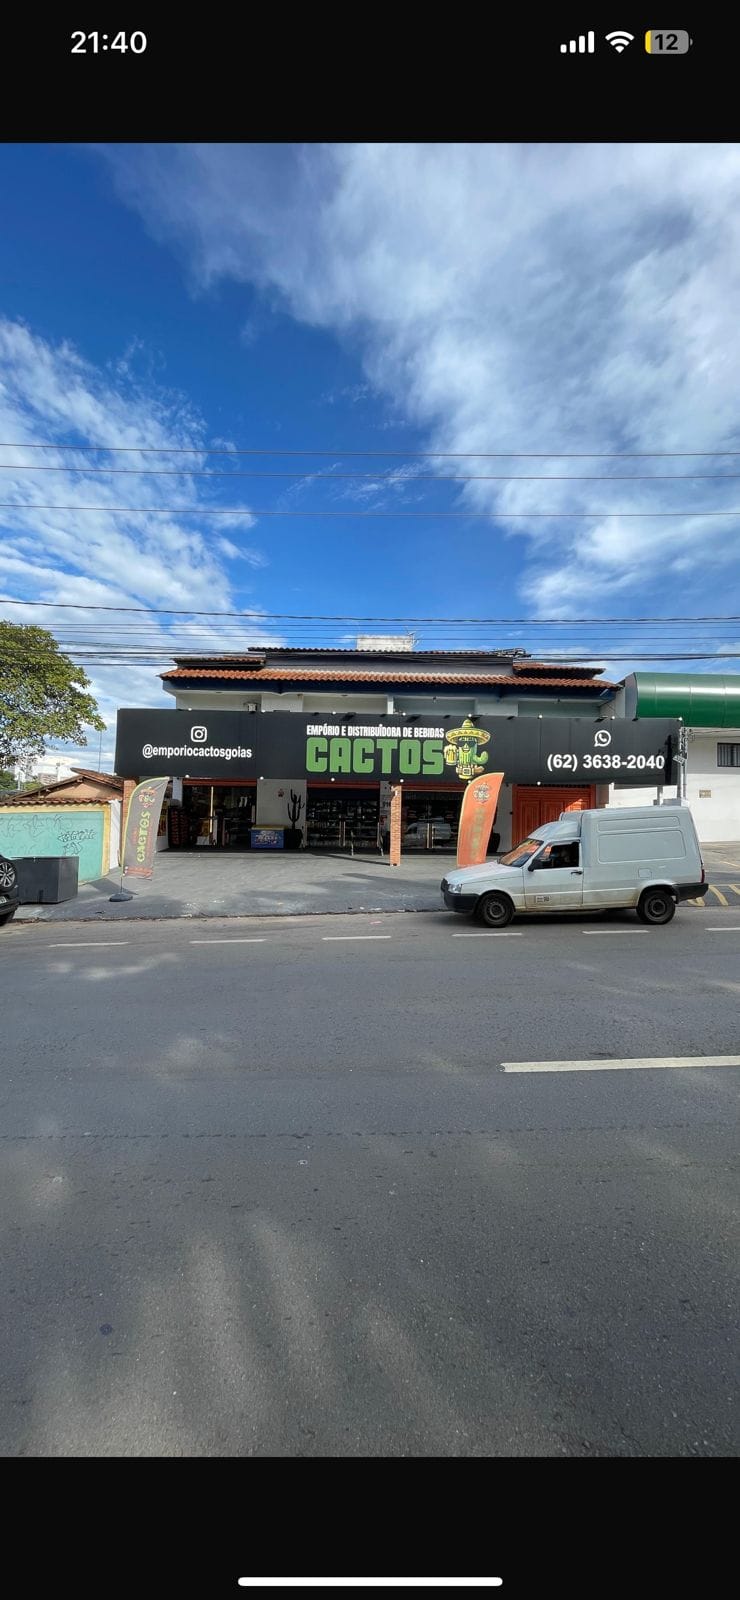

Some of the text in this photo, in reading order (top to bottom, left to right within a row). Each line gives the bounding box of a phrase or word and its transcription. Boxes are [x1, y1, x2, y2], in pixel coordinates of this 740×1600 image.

[306, 723, 340, 736] EMPÓRIO
[341, 725, 347, 736] E
[403, 727, 413, 738] DE
[413, 727, 445, 739] BEBIDAS
[142, 743, 253, 761] @emporiocactosgoias
[306, 737, 444, 774] CACTOS
[546, 753, 665, 772] (62) 3638-2040
